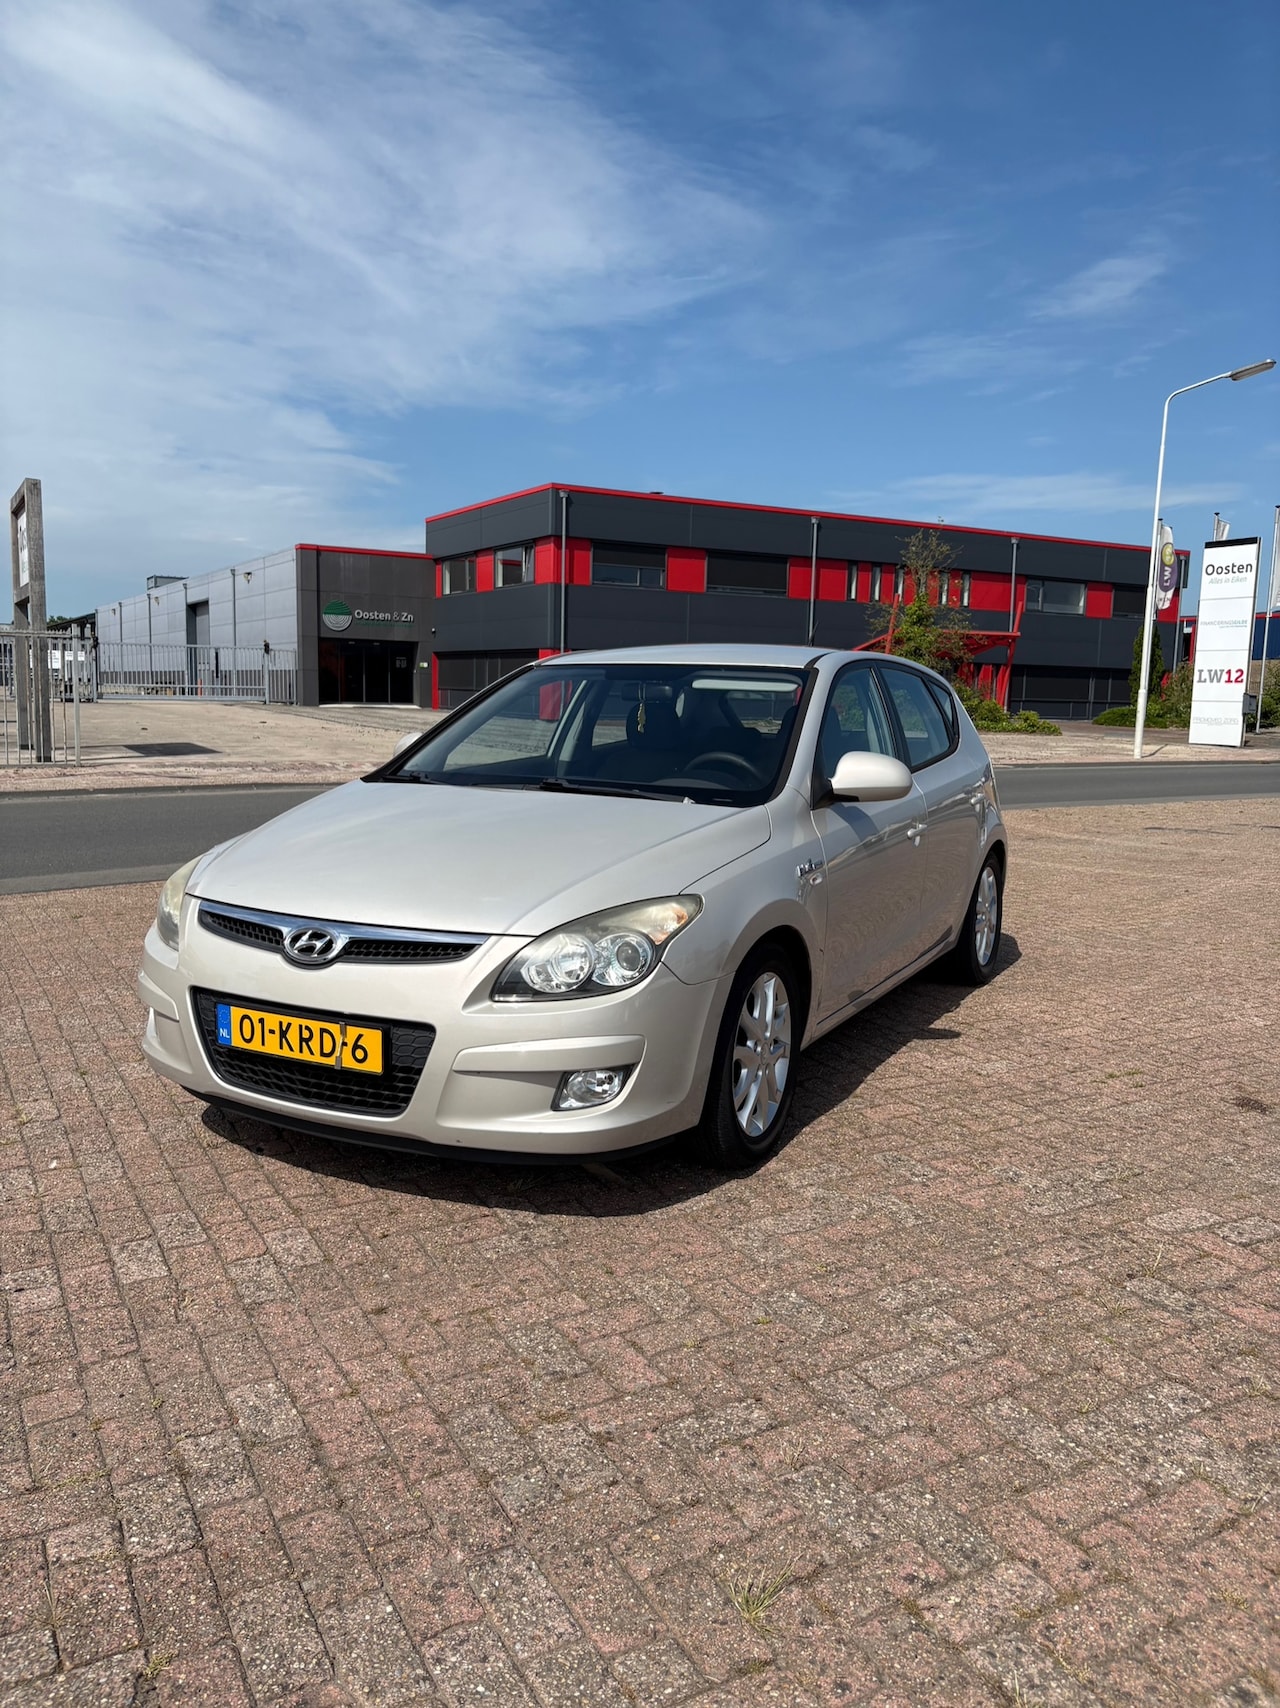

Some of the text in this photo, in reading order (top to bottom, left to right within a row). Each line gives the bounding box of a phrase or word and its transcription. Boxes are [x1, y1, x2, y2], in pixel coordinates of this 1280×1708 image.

[1205, 562, 1253, 576] Oosten
[354, 609, 414, 622] Oosten & Zn
[1197, 668, 1244, 683] LW12
[219, 1027, 230, 1039] NL
[239, 1014, 368, 1064] 01-KRD-6
